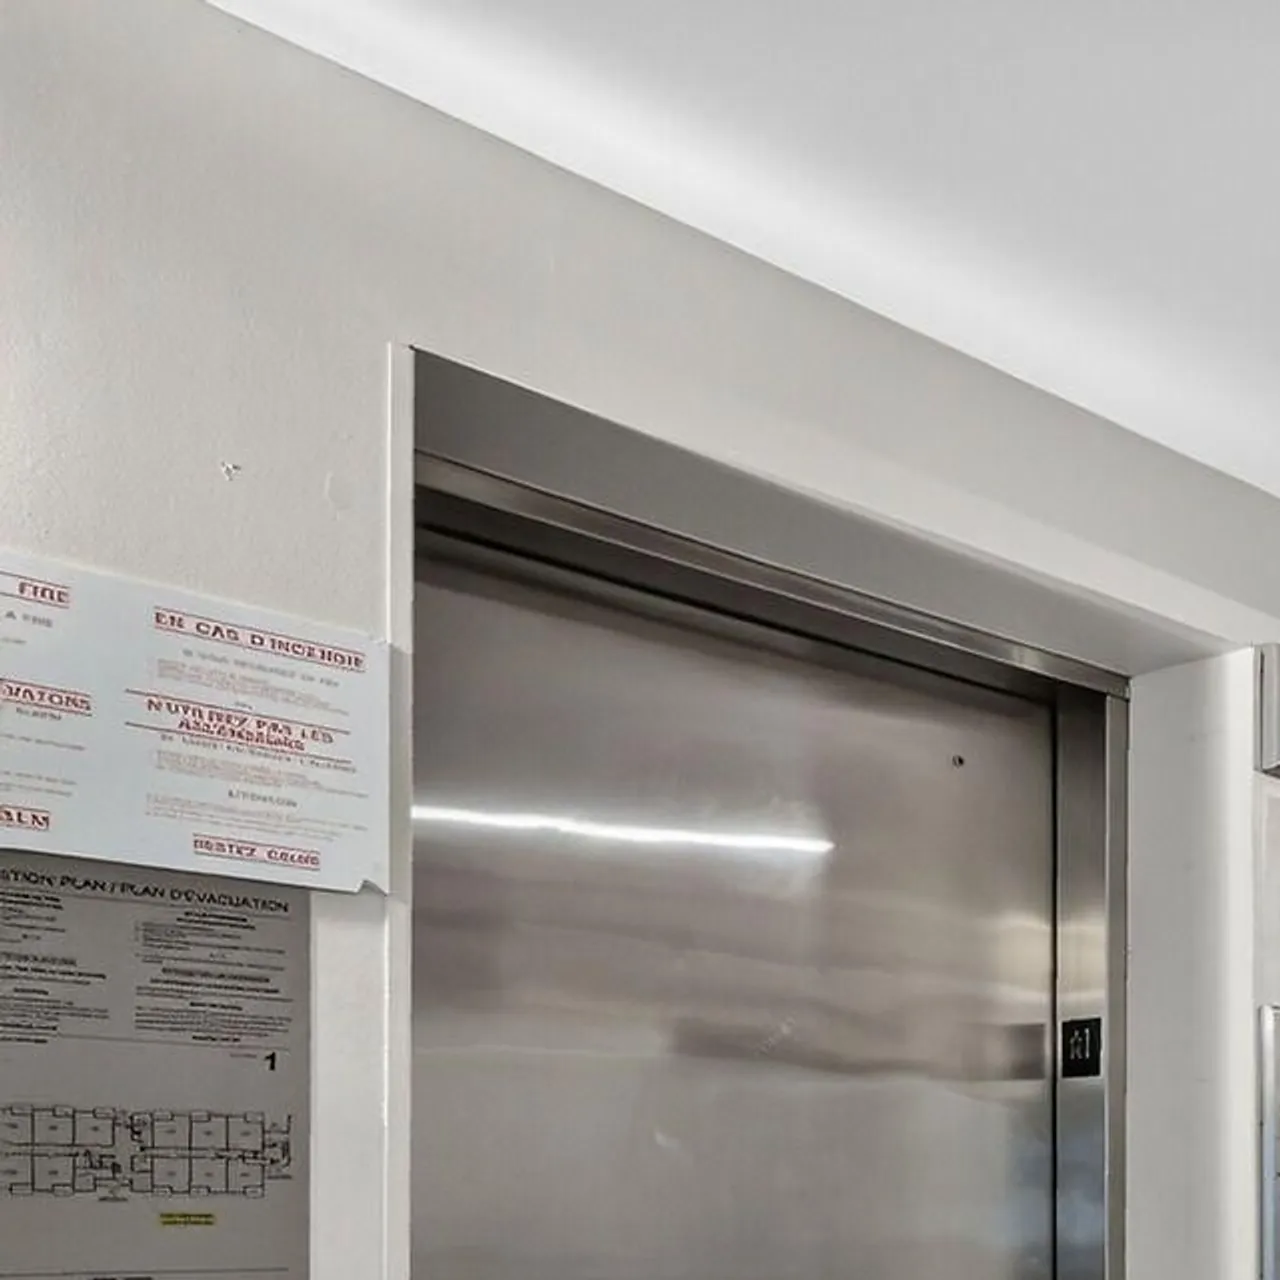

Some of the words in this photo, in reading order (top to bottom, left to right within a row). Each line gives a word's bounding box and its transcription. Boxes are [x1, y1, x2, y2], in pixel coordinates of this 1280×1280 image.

[155, 611, 185, 630] EN
[195, 621, 240, 642] CAS
[0, 683, 91, 712] VATORS
[264, 1052, 277, 1071] 1
